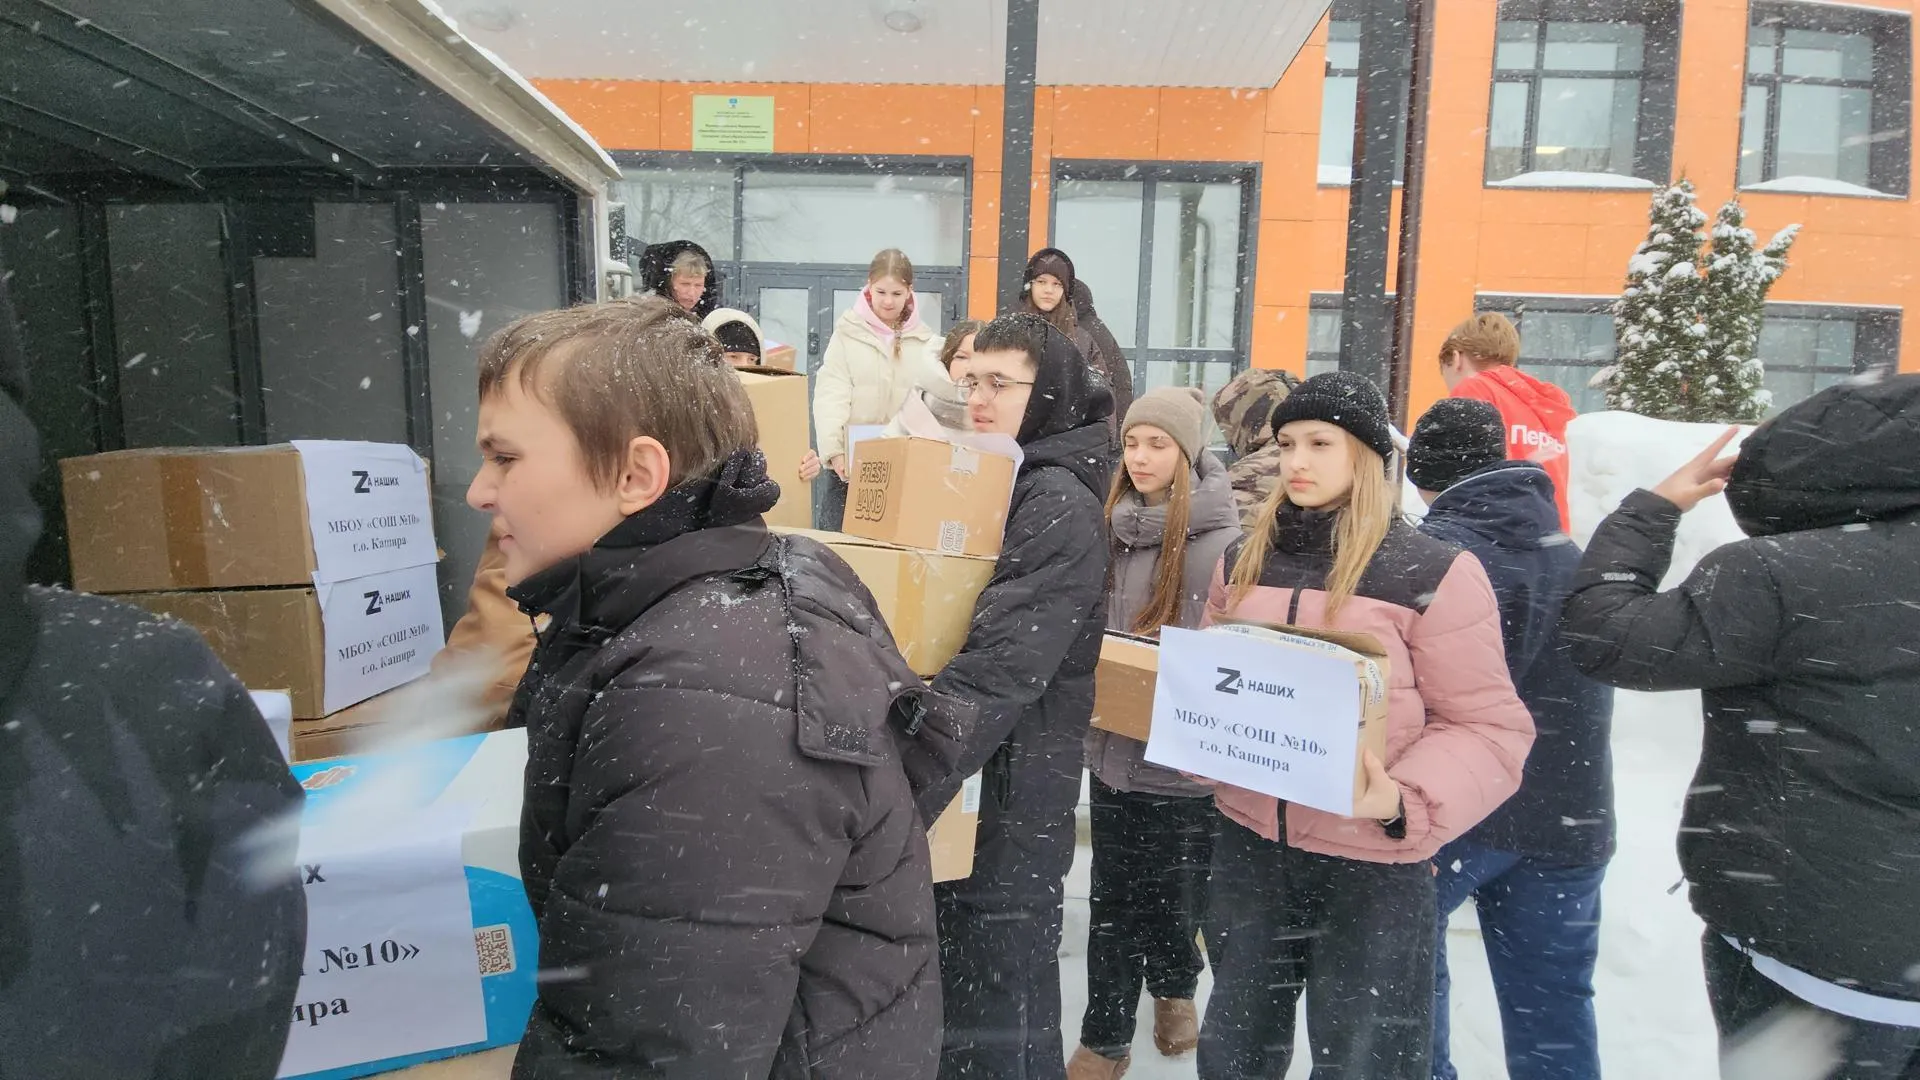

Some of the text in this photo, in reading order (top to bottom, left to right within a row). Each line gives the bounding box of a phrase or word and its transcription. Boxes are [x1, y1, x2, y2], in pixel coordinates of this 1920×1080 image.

[374, 477, 400, 487] НАШИХ
[859, 461, 891, 487] FRESH
[854, 487, 887, 522] LAND
[328, 518, 363, 534] МБОУ
[367, 515, 397, 529] «СОШ
[353, 536, 407, 553] г.о. Кашира
[385, 590, 411, 605] НАШИХ
[338, 639, 374, 662] МБОУ
[377, 627, 407, 649] «СОШ
[361, 649, 416, 676] г.о. Кашира
[1247, 679, 1296, 700] НАШИХ
[1173, 707, 1328, 758] МБОУ «СОШ №10»
[1199, 740, 1290, 773] г.о. Кашира
[319, 939, 421, 974] №10»
